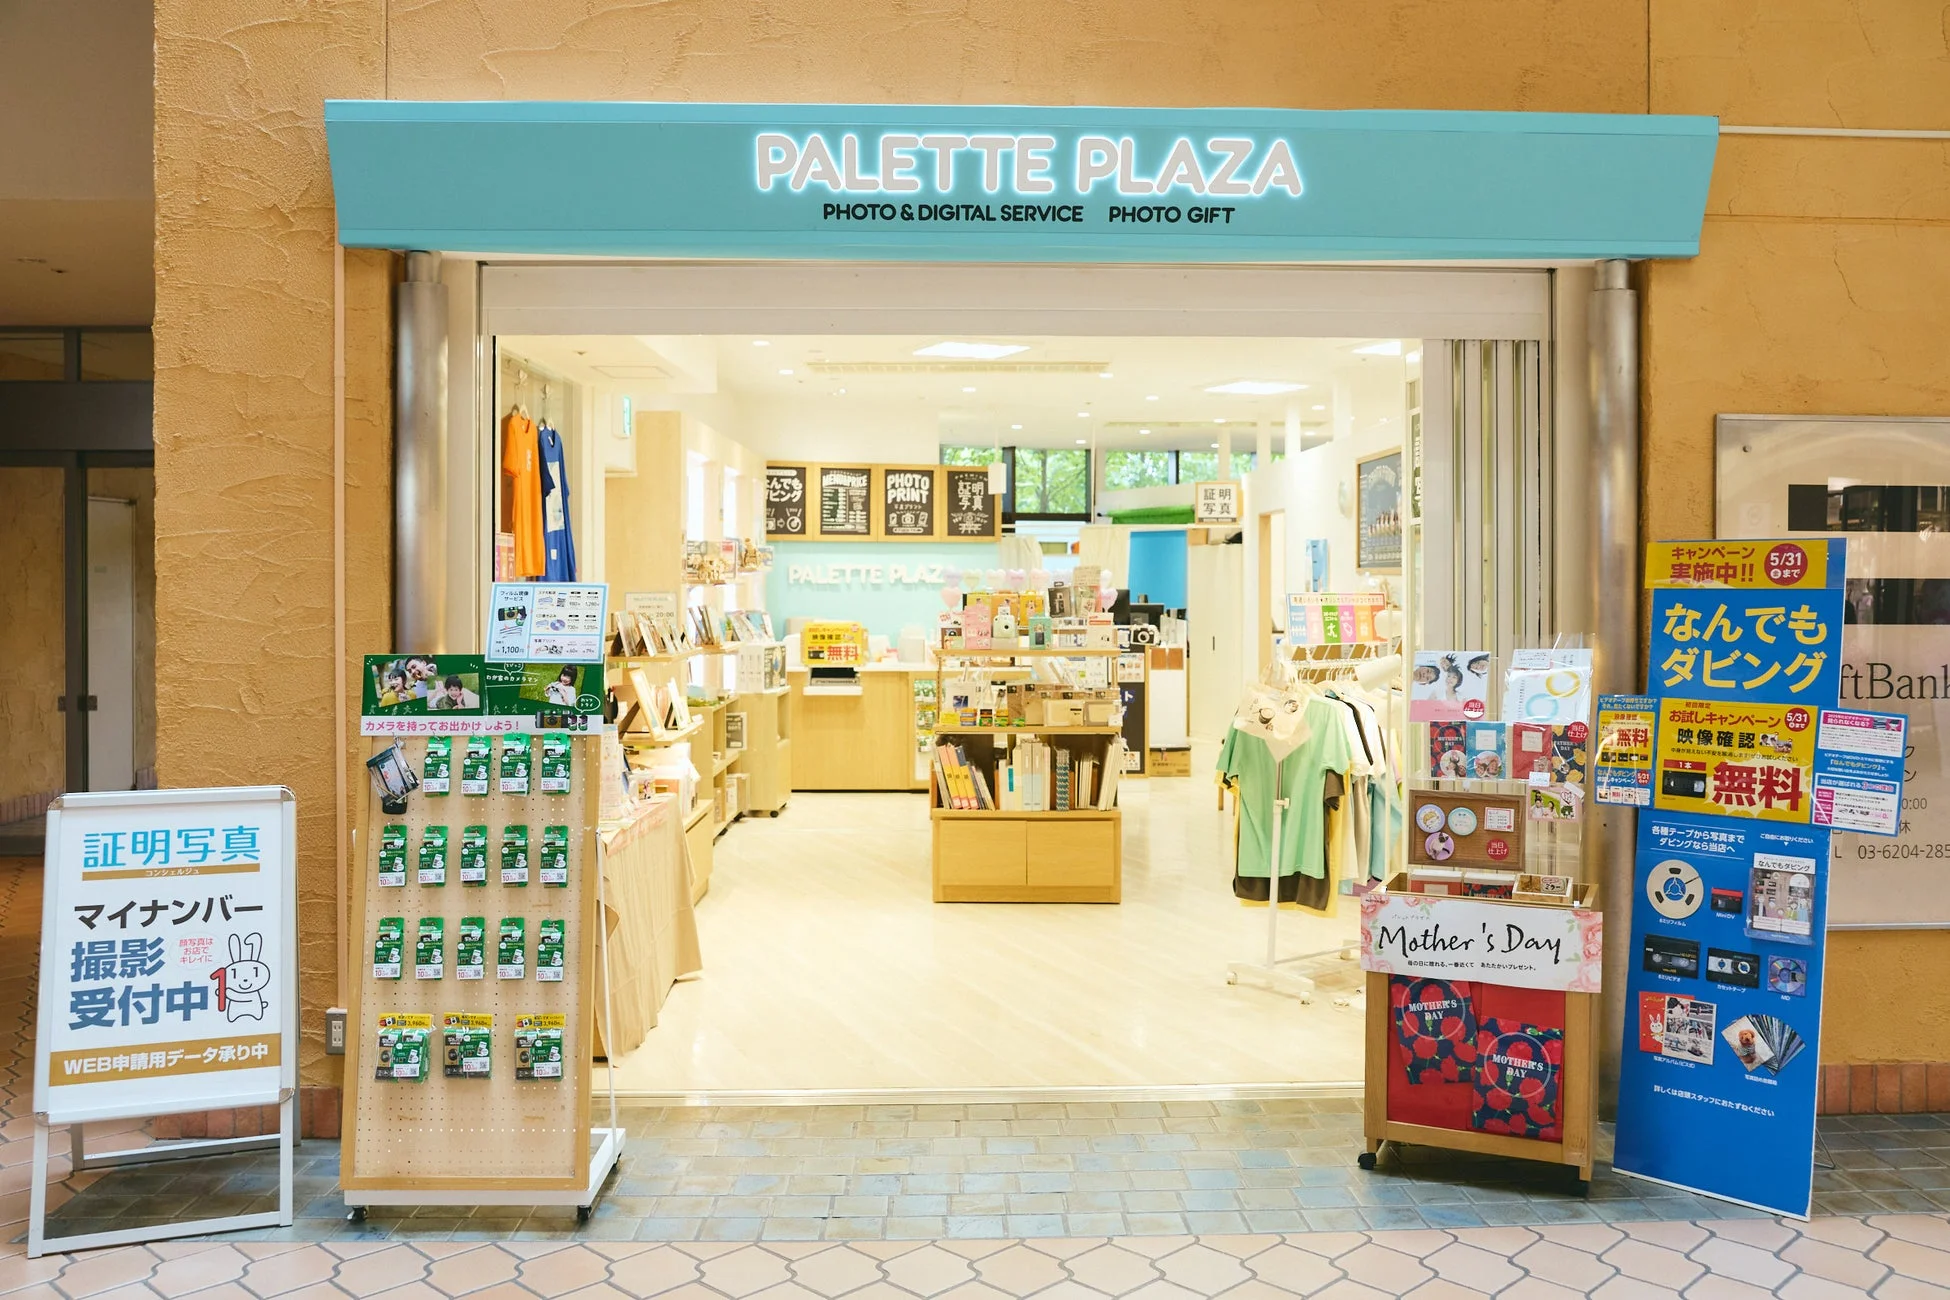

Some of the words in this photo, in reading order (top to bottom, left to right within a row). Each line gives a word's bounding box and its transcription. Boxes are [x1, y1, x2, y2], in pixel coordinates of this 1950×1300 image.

[756, 134, 1056, 193] PALETTE
[1077, 137, 1303, 197] PLAZA
[823, 203, 897, 221] PHOTO
[900, 204, 914, 221] &
[918, 204, 997, 222] DIGITAL
[1000, 205, 1084, 223] SERVICE
[1109, 206, 1182, 223] PHOTO
[1187, 206, 1235, 224] GIFT
[887, 473, 930, 490] PHOTO
[767, 489, 803, 503] ビング
[887, 487, 929, 504] PRINT
[1203, 488, 1232, 501] 証明
[1203, 502, 1232, 515] 写真
[1671, 546, 1755, 560] キャンペーン
[1770, 552, 1801, 566] 5/31
[788, 563, 884, 584] PALETTE
[888, 563, 945, 584] PLAZ
[1670, 562, 1754, 584] 実施中!!
[1663, 603, 1828, 645] なんでも
[827, 645, 859, 660] 無料
[1661, 647, 1828, 694] ダビング
[1669, 710, 1781, 728] お試しキャンペーン
[1786, 712, 1808, 723] 5/31
[1567, 731, 1588, 739] 仕上げ
[1617, 728, 1649, 748] 無料
[1677, 728, 1755, 748] 映像確認
[1678, 762, 1693, 770] 1本
[1712, 762, 1803, 811] 無料
[1651, 825, 1745, 844] 各種テープから写真まで
[84, 826, 260, 868] 証明写真
[1490, 841, 1504, 849] 当日
[1659, 837, 1735, 853] ダビングなら当店へ
[145, 868, 200, 877] コンシェルジュ
[1758, 860, 1810, 872] なんでもダビング
[74, 894, 263, 930] マイナンバー
[179, 937, 213, 947] 顔写真は
[1379, 922, 1495, 958] Mother's
[1501, 923, 1561, 965] Day
[70, 936, 166, 982] 撮影
[180, 954, 213, 964] キレイに
[184, 947, 209, 955] お店で
[68, 981, 209, 1030] 受付中
[1408, 999, 1457, 1012] MOTHER'S
[1424, 1011, 1444, 1020] DAY
[64, 1043, 268, 1076] WEB申請用データ承り中
[1492, 1054, 1544, 1071] MOTHER'S
[1506, 1067, 1527, 1078] DAY
[1653, 1085, 1775, 1117] 詳しくは店頭スタッフにおたずねください
